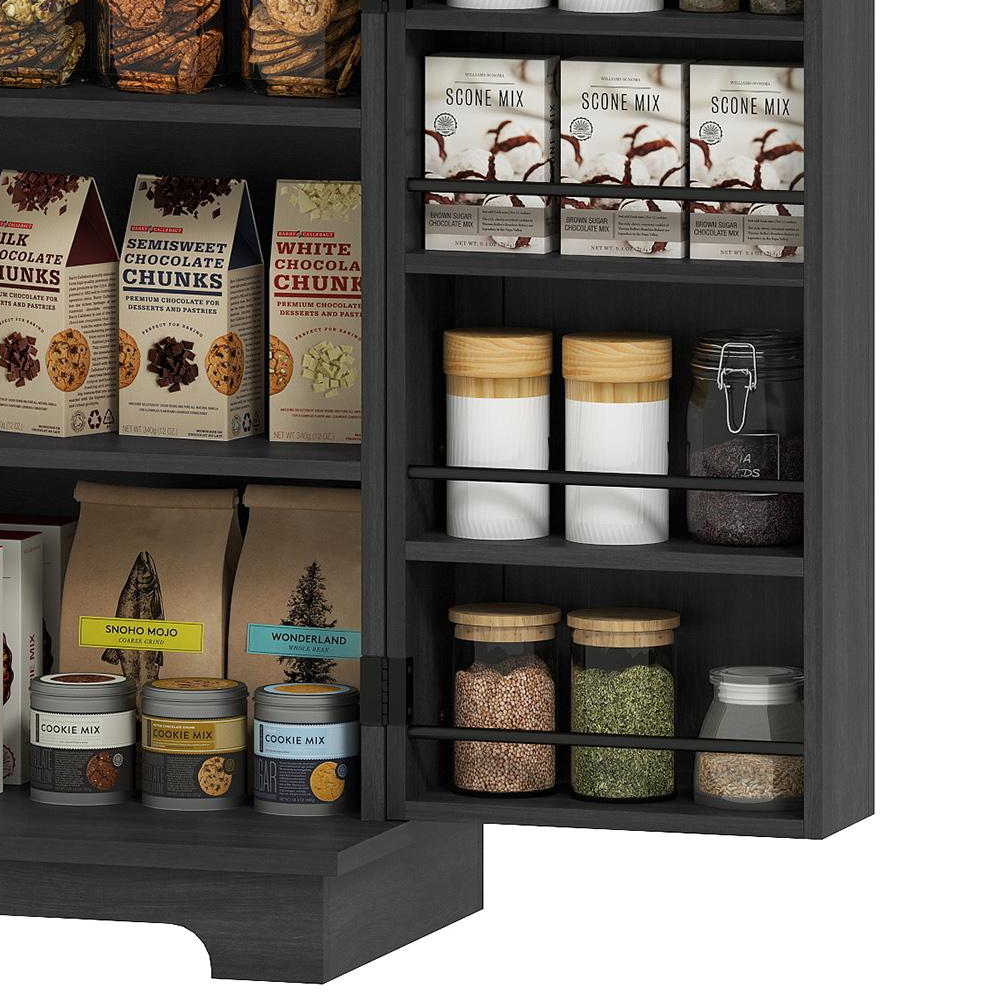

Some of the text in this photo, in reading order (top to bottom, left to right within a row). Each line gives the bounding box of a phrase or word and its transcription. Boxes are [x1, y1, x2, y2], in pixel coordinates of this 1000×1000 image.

[446, 87, 524, 108] SCONE MIX
[581, 92, 660, 112] SCONE MIX
[711, 96, 790, 116] SCONE MIX
[589, 217, 608, 225] SUGAR
[696, 221, 738, 229] BROWN SUGAR
[564, 224, 598, 232] CHOCOLATE
[694, 229, 727, 237] CHOCOLATE
[127, 238, 227, 254] SEMISWEET
[276, 242, 351, 256] WHITE
[124, 253, 224, 269] CHOCOLATE
[275, 258, 360, 272] CHOCOLA
[122, 268, 223, 289] CHUNKS
[274, 274, 362, 292] CHUNK
[9, 292, 44, 301] CHOCOLATE
[13, 300, 26, 308] AND
[27, 302, 56, 311] PASTRIES
[128, 304, 164, 312] DESSERTS
[183, 307, 218, 315] PASTRIES
[106, 625, 178, 637] SNOHO MOJO
[272, 632, 346, 645] WONDERLAND
[40, 724, 101, 734] COOKIE MIX
[153, 729, 212, 740] COOKIE MIX
[265, 734, 325, 744] COOKIE MIX
